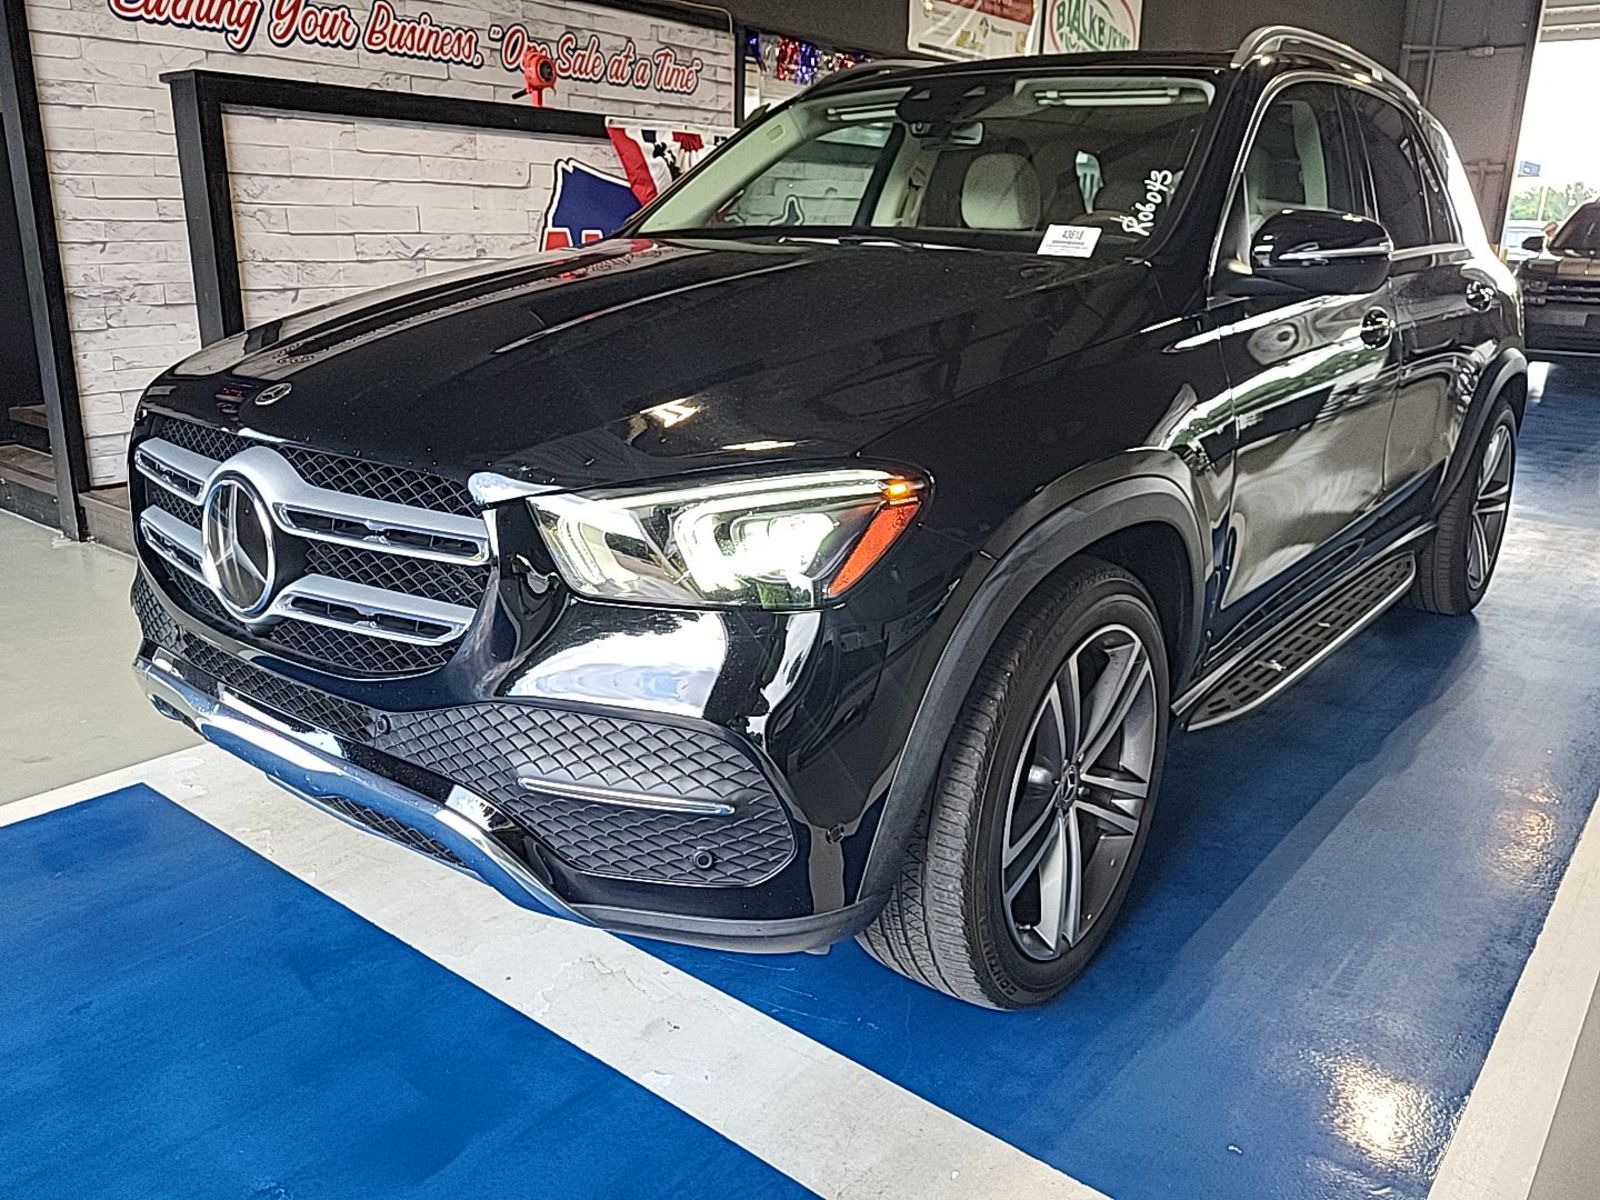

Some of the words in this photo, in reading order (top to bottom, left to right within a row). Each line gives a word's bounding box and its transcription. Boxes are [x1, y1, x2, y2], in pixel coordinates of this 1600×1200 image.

[268, 0, 359, 49] Your
[364, 1, 484, 67] Business.
[556, 33, 605, 82] Sale
[606, 41, 636, 85] at
[632, 59, 651, 89] a
